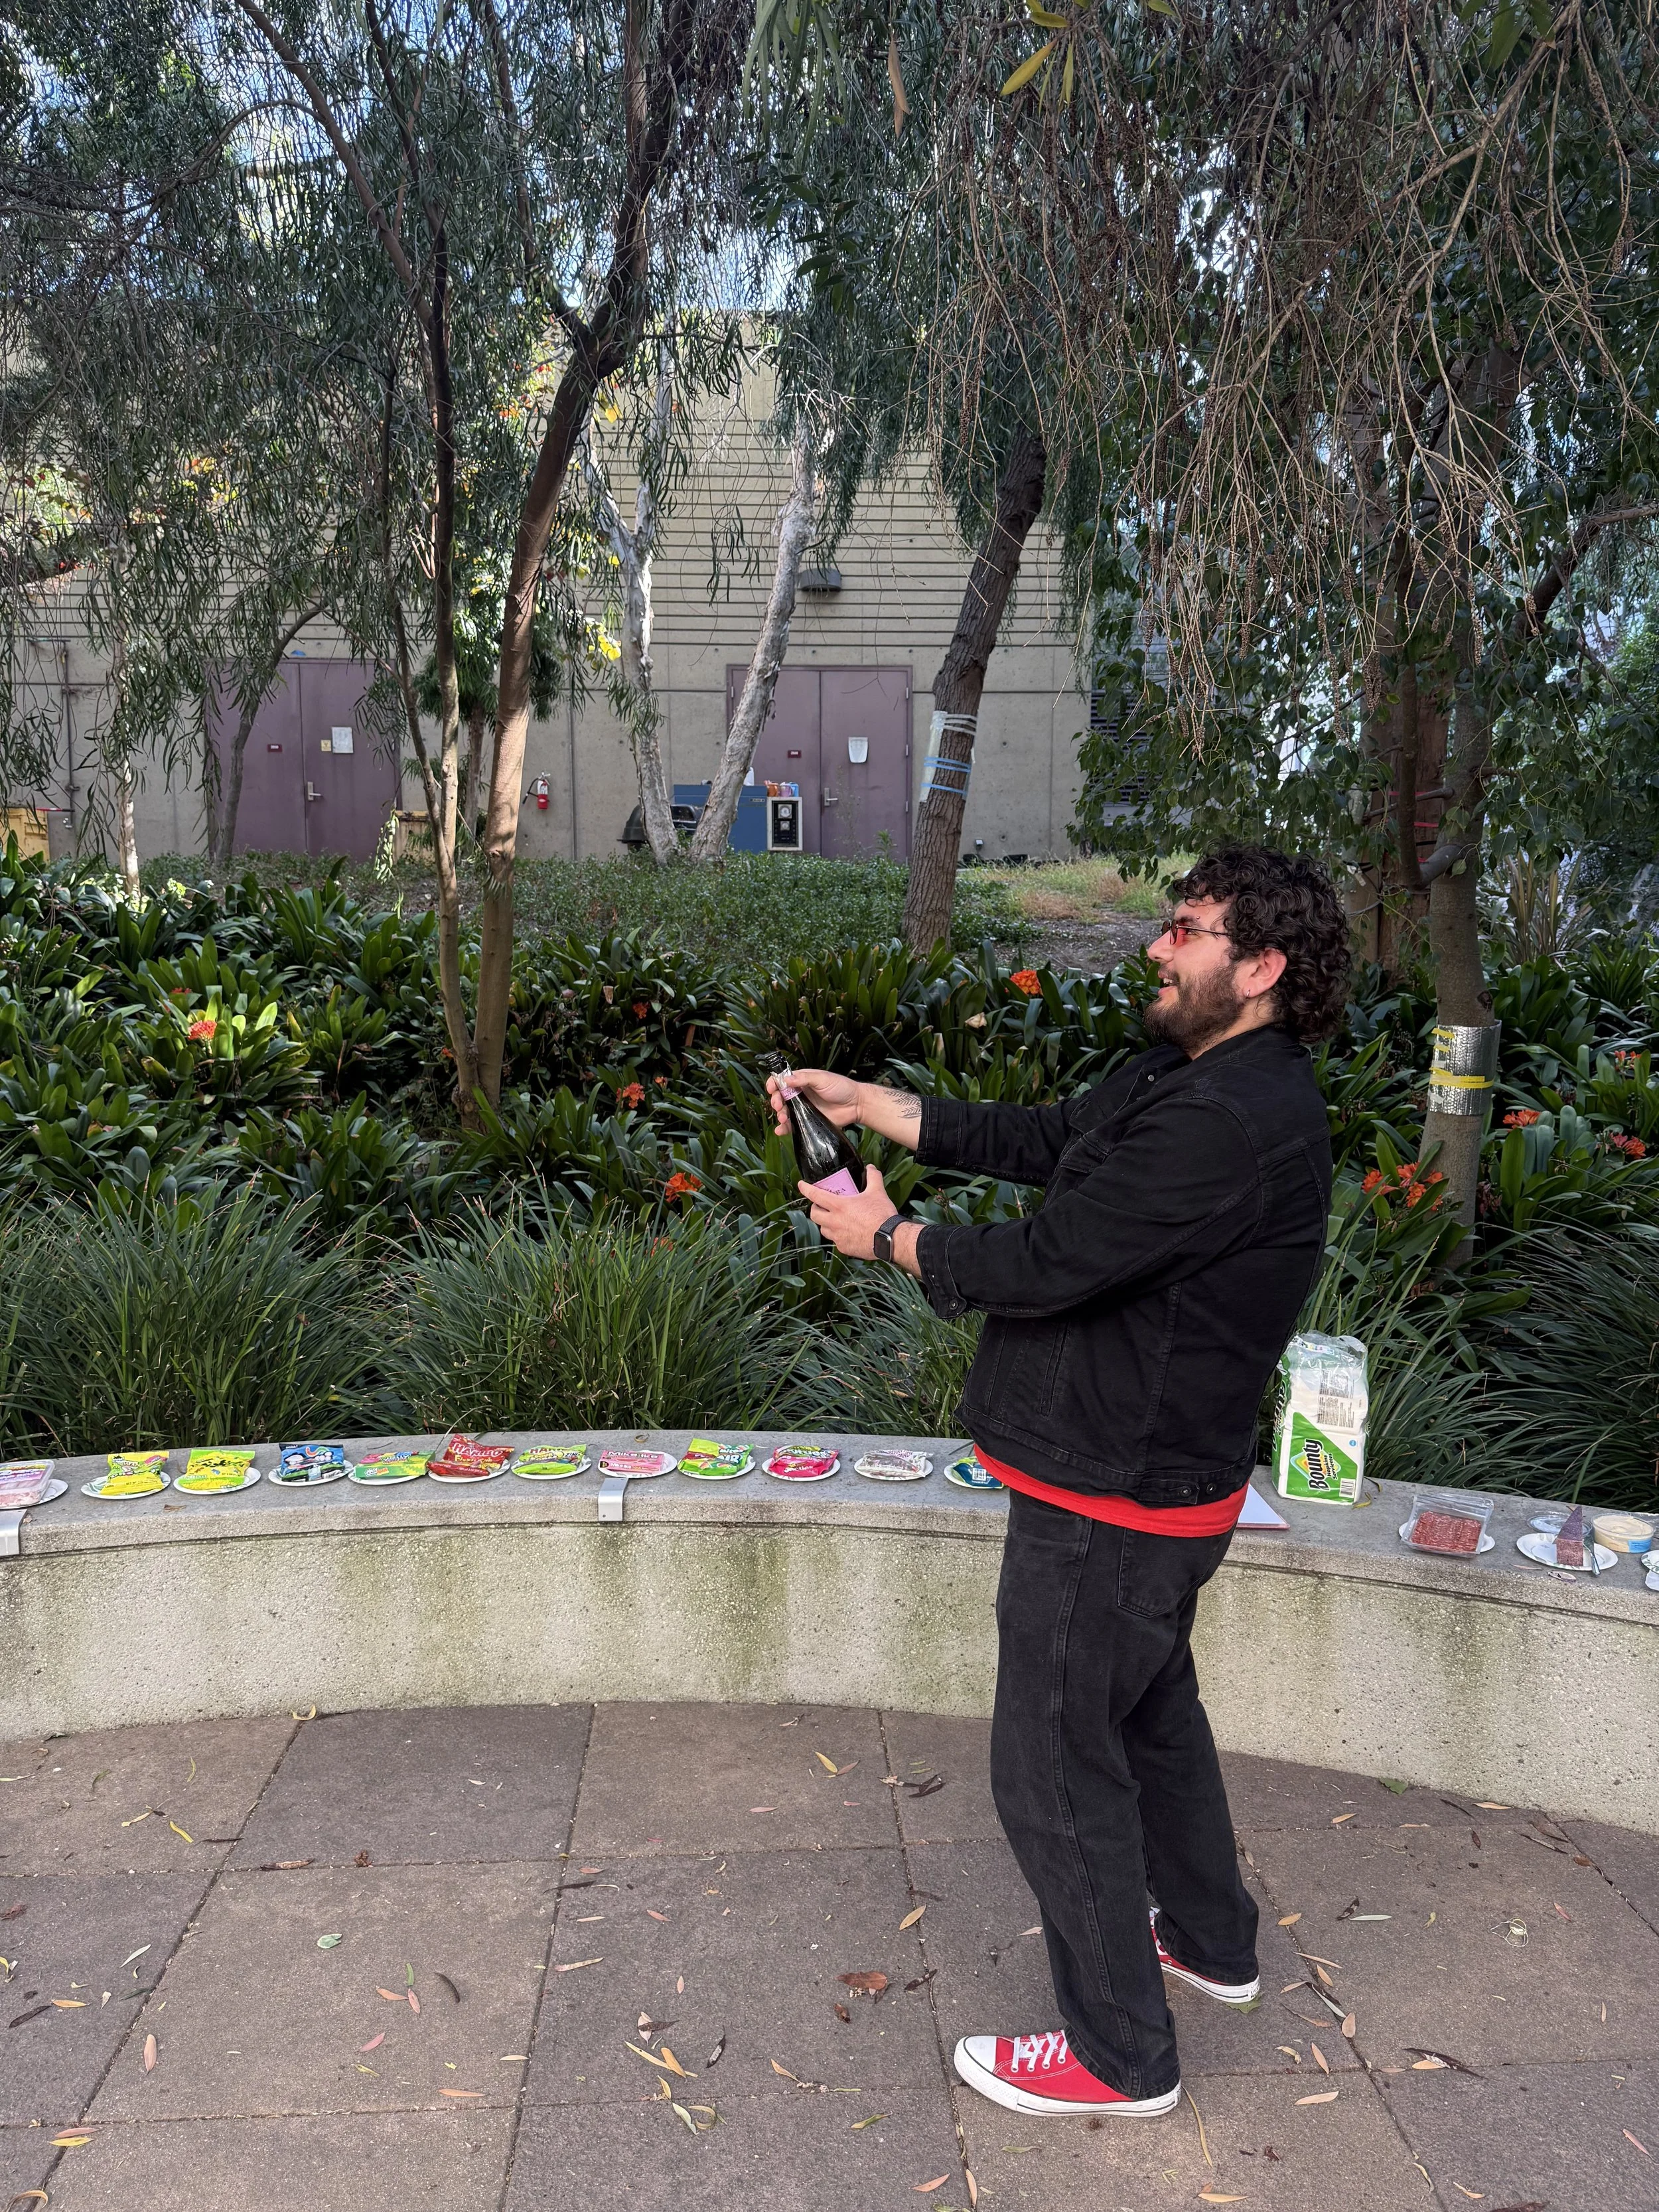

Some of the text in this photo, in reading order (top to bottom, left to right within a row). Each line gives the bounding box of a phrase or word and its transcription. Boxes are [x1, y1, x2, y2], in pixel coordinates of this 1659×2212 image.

[452, 1442, 504, 1457] HARIBO
[1302, 1438, 1330, 1491] Bounty
[1329, 1453, 1337, 1479] Serviettes
